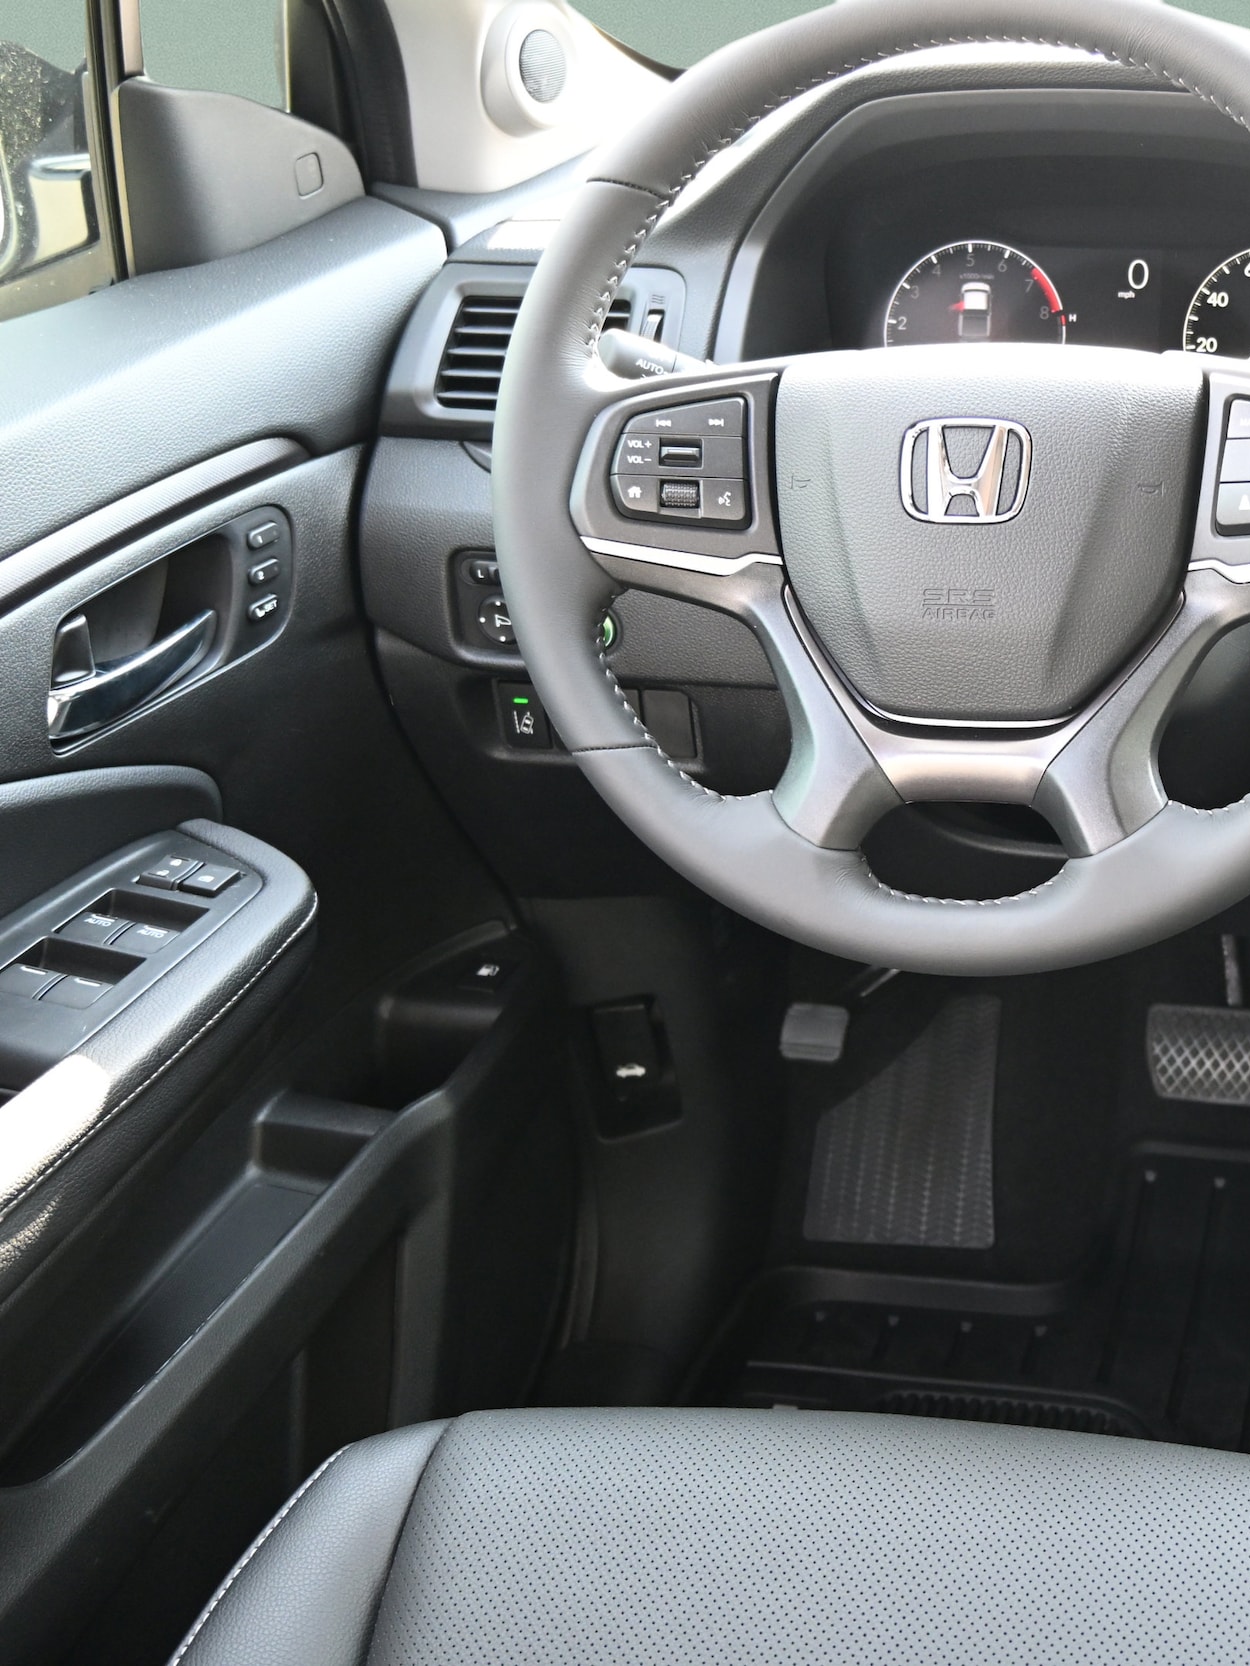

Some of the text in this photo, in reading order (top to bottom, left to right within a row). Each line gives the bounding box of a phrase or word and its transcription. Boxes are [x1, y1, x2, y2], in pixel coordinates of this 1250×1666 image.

[966, 254, 975, 267] 5
[998, 261, 1007, 273] 6
[931, 266, 941, 277] 4
[1128, 259, 1149, 289] 0
[910, 286, 919, 298] 3
[1025, 279, 1034, 292] 7
[1118, 290, 1135, 299] mph
[1206, 291, 1229, 308] 40
[1040, 306, 1049, 320] 8
[1069, 313, 1077, 322] H
[897, 316, 907, 330] 2
[1196, 337, 1218, 353] 20
[636, 358, 664, 375] AUTO
[257, 534, 264, 544] 1
[477, 569, 484, 579] L
[922, 588, 996, 603] SRS
[921, 607, 996, 620] AIRBAG
[84, 917, 112, 927] AUTO
[137, 929, 165, 938] AUTO
